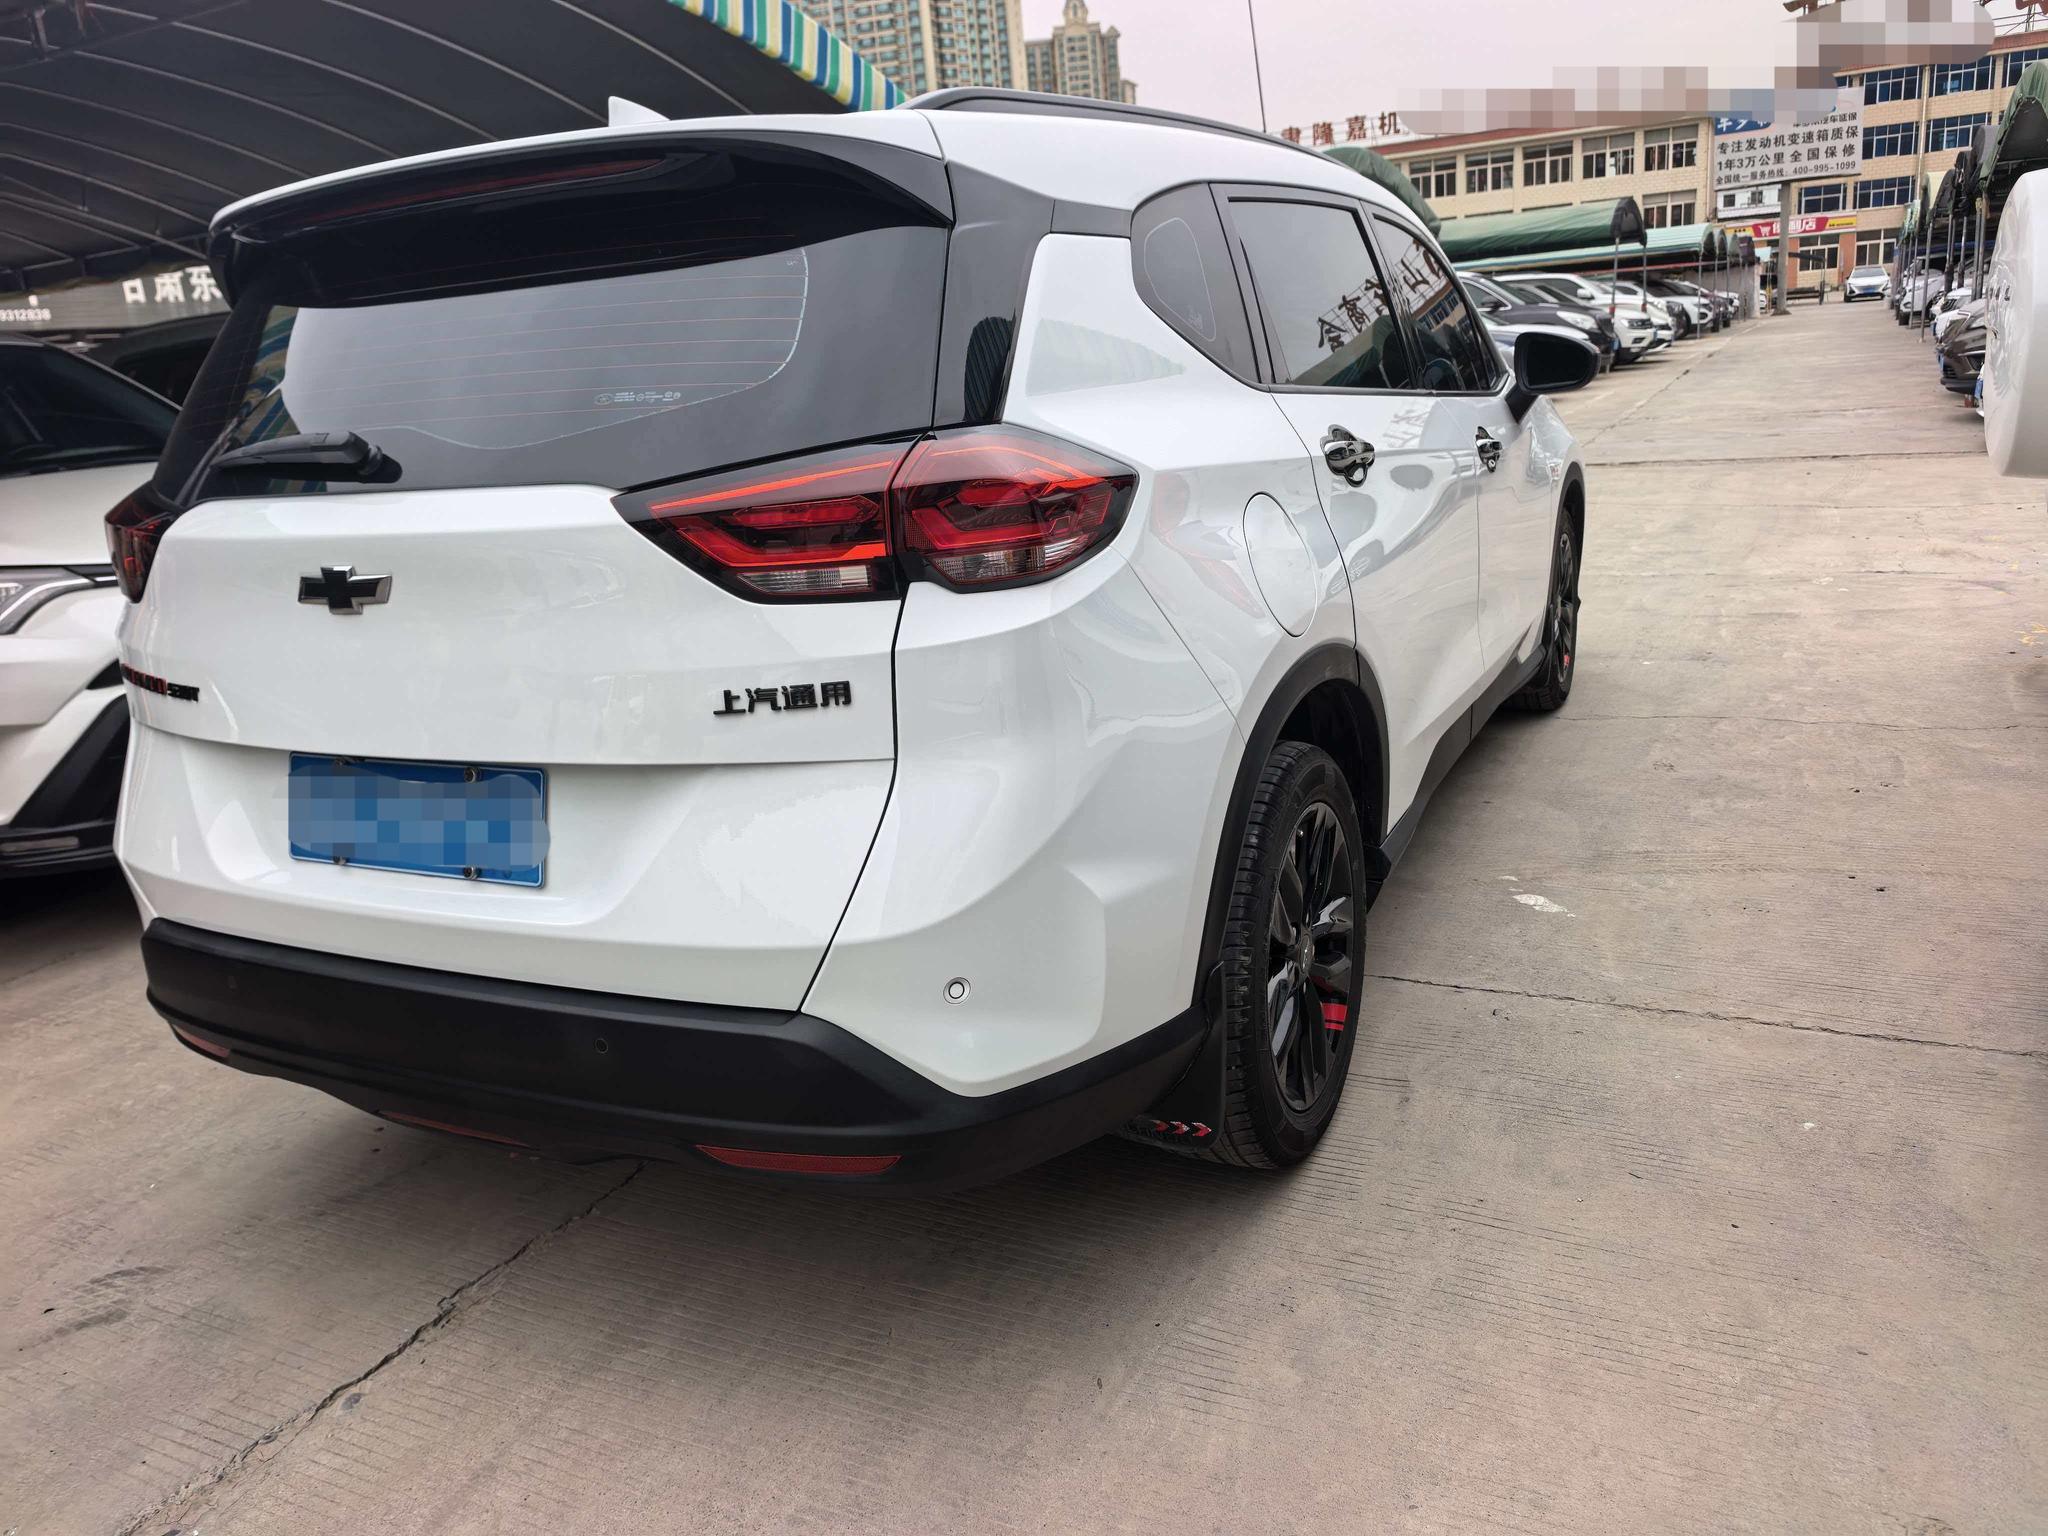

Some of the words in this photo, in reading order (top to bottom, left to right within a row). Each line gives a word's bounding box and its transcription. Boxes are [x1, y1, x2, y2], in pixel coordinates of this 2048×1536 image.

[1718, 125, 1860, 155] 专注发动机变速箱质保
[713, 680, 852, 715] 上汽通用
